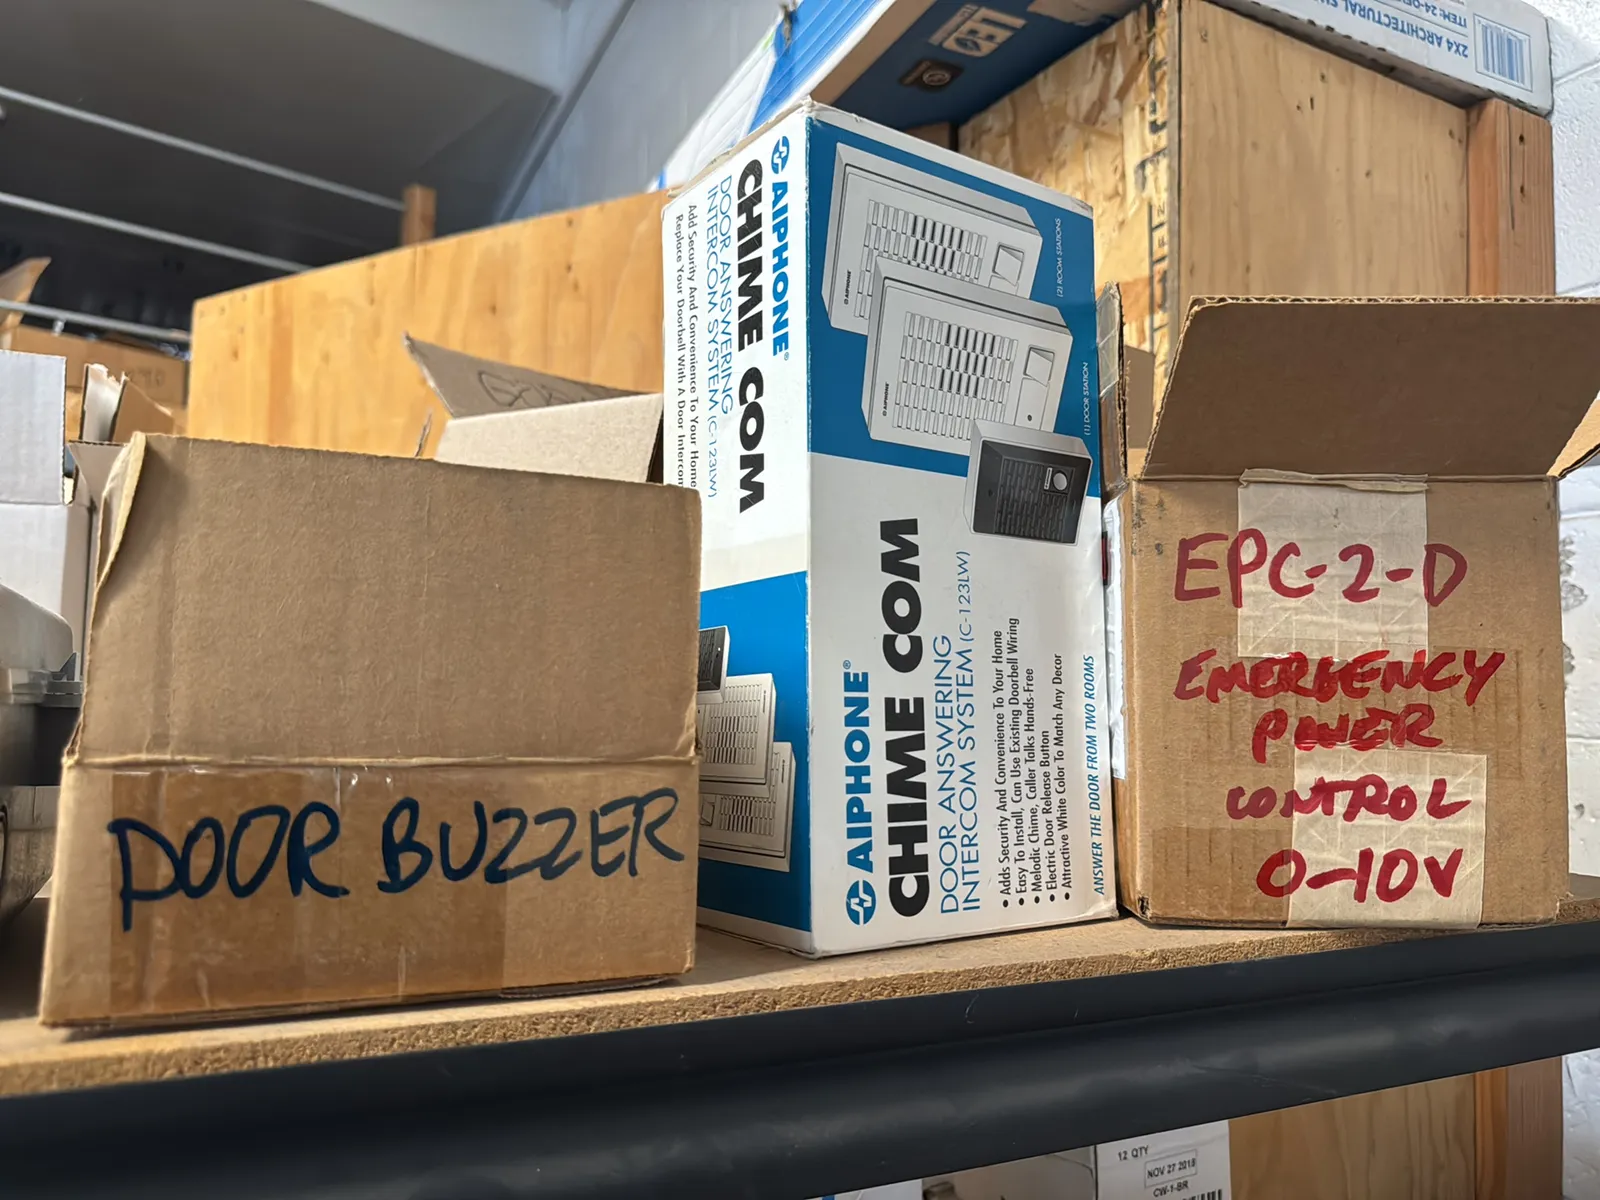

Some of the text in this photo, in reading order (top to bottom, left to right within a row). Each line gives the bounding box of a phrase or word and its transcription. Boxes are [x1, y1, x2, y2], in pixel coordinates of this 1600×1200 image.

[1344, 0, 1469, 58] 2X4 ARCHITECTURAL
[1440, 8, 1467, 28] ITEM:
[675, 214, 685, 263] Replace
[676, 265, 685, 294] Your
[706, 184, 719, 313] INTERCOM
[677, 299, 686, 352] Doorbell
[719, 175, 734, 415] DOOR ANSWERING
[737, 159, 765, 514] CHIME COM
[677, 354, 686, 383] With
[687, 204, 699, 488] Add Security And Convenience To Your Home
[707, 318, 720, 411] SYSTEM
[1082, 361, 1090, 396] STATION
[677, 387, 686, 396] A
[677, 400, 686, 430] Door
[1083, 397, 1091, 423] DOOR
[1174, 528, 1468, 608] EPC-2-D
[880, 518, 930, 917] CHIME COM
[1173, 648, 1505, 706] EMERGENCY
[955, 551, 981, 911] INTERCOM SYSTEM (C-123LW)
[991, 630, 1011, 895] Adds Security And Convenience To Your Home
[1006, 618, 1028, 894] Easy To Install, Can Use Existing Doorbell Wiring
[1052, 654, 1072, 889] Attractive White Color To Match Any Decor
[932, 635, 959, 914] DOOR ANSWERING
[1022, 668, 1042, 892] Melodic Chime, Caller Talks Hands-Free
[1039, 730, 1058, 890] Electric Door Release Button
[1083, 655, 1105, 895] ANSWER THE DOOR FROM TWO ROOMS
[1226, 774, 1472, 822] CONTROL
[107, 787, 685, 932] DOOR BUZZER
[1118, 1145, 1149, 1161] 12 QTY
[1146, 1166, 1166, 1179] NOV
[1167, 1162, 1176, 1174] 27
